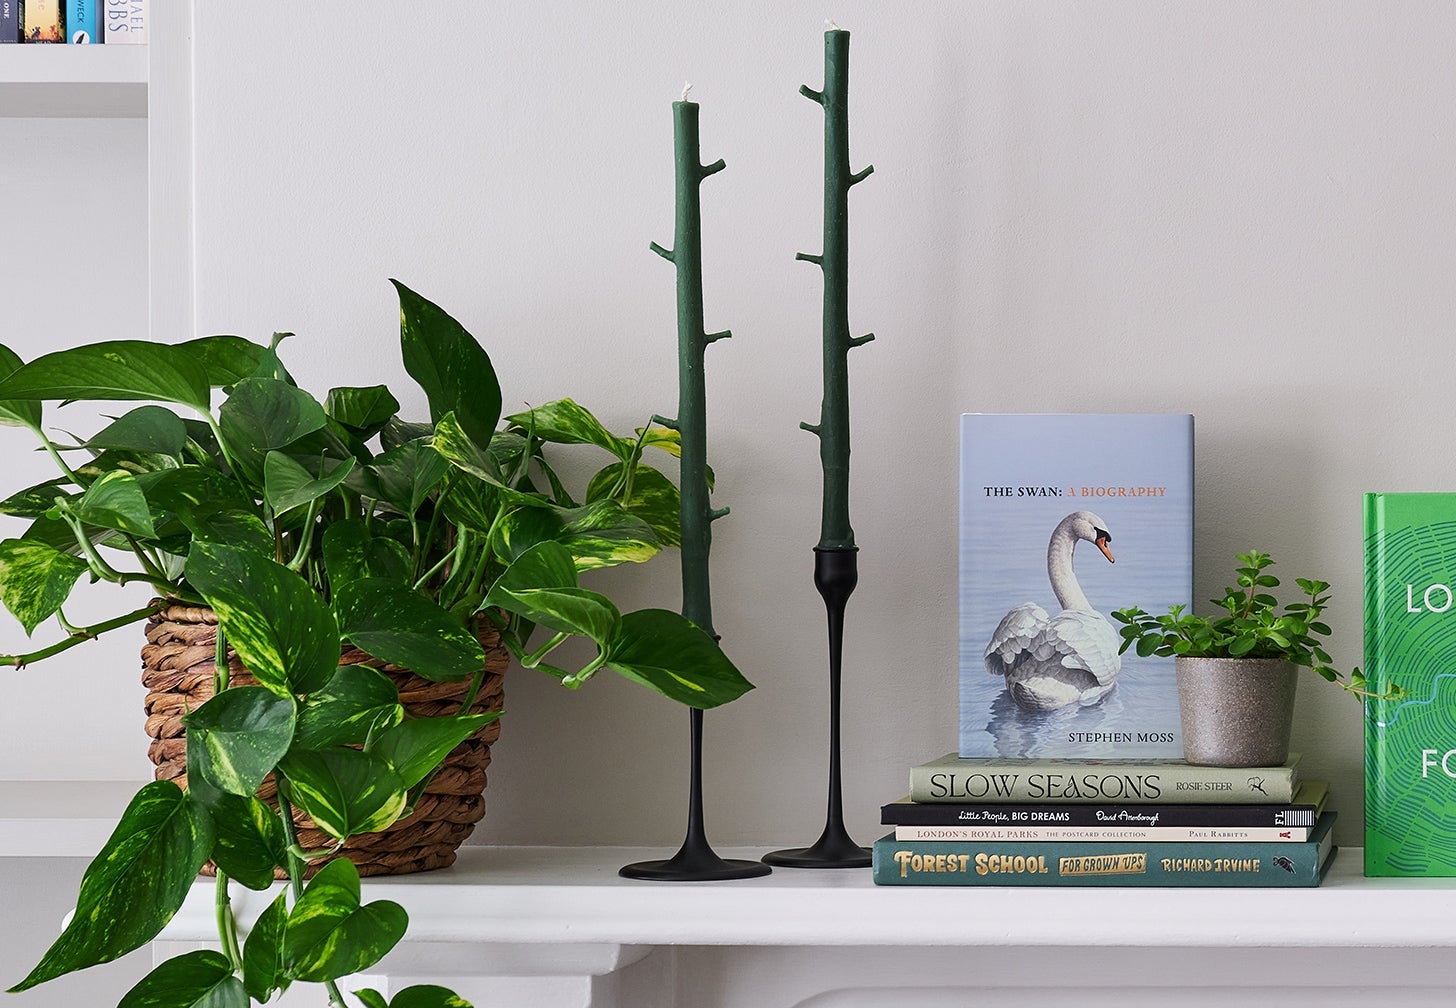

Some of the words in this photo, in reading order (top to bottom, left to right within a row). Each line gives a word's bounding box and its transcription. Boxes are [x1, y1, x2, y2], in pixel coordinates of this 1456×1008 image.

[984, 487, 1013, 497] THE
[1017, 486, 1062, 497] SWAN:
[1067, 487, 1076, 497] A
[1082, 487, 1167, 497] BIOGRAPHY
[1069, 732, 1132, 743] STEPHEN
[1137, 732, 1174, 743] MOSS
[930, 774, 1019, 798] SLOW
[1028, 774, 1161, 799] SEASONS
[1176, 782, 1203, 791] ROSIE
[1204, 782, 1232, 791] STEER
[958, 810, 981, 820] Little
[982, 810, 1010, 823] People,
[1012, 812, 1030, 821] BIG
[1031, 812, 1070, 821] DREAMS
[1096, 810, 1117, 821] David
[917, 830, 968, 838] LONDON'S
[971, 830, 1003, 838] ROYAL
[1007, 830, 1038, 838] PARKS
[894, 850, 970, 878] FOREST
[975, 852, 1048, 875] SCHOOL
[1062, 859, 1080, 873] FOR
[1083, 856, 1119, 872] GROWN
[1161, 858, 1212, 873] RICHARD
[1215, 859, 1260, 873] IRVINE
